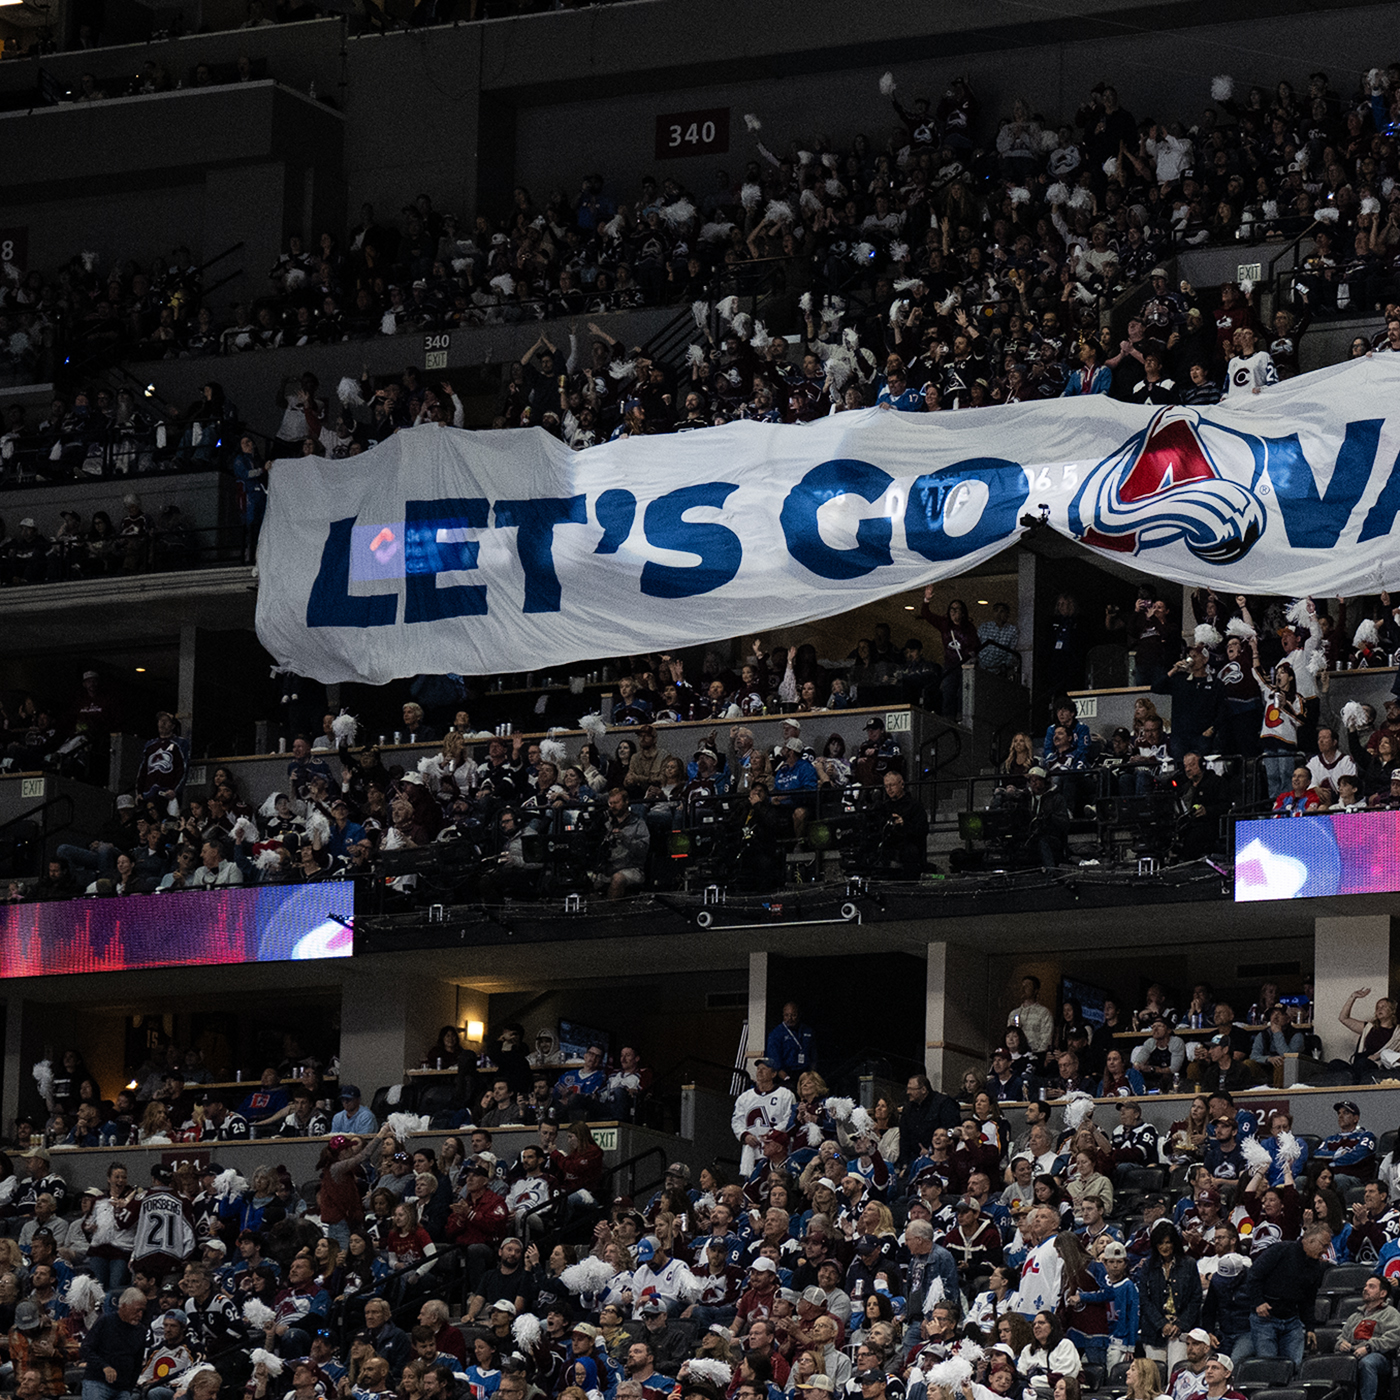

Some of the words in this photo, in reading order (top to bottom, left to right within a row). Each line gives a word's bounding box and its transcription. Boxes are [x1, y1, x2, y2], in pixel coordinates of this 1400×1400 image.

[669, 122, 715, 147] 340
[1239, 266, 1260, 281] EXIT
[425, 334, 449, 350] 340
[426, 354, 447, 369] EXIT
[306, 482, 745, 628] LET'S
[780, 457, 1028, 580] GO
[887, 714, 909, 730] EXIT
[22, 781, 43, 796] EXIT
[770, 1095, 777, 1104] C
[1242, 1122, 1250, 1132] 8
[1141, 1133, 1155, 1144] 92
[1361, 1137, 1373, 1149] 29
[142, 1199, 181, 1215] FORSBERG
[149, 1212, 176, 1242] 21
[732, 1250, 739, 1261] 8
